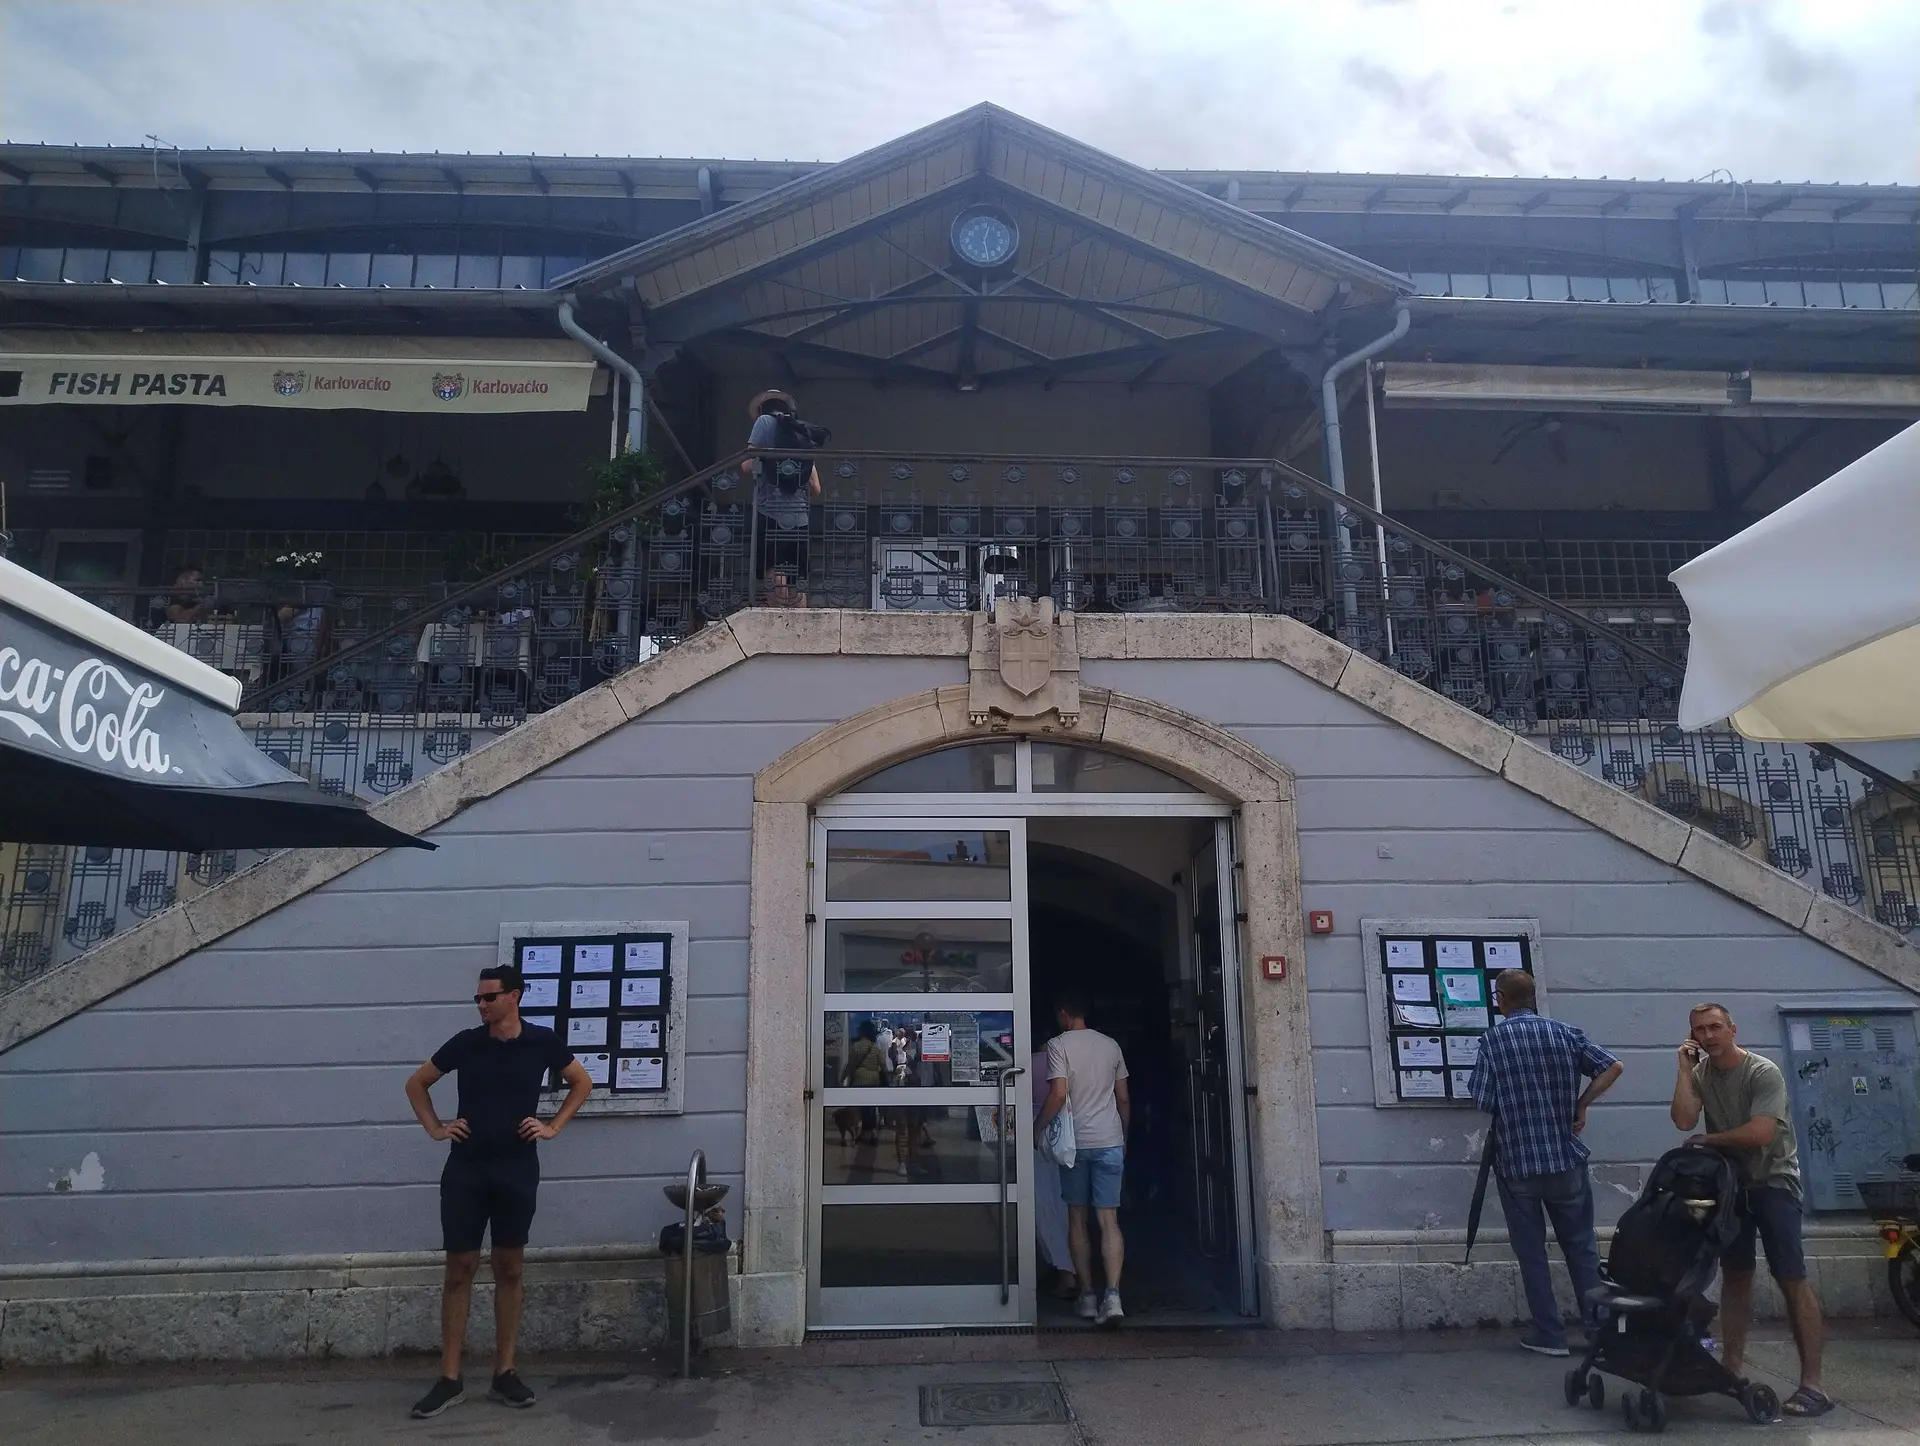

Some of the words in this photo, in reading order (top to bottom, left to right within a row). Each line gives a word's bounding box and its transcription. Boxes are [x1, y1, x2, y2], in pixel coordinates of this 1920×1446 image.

[49, 372, 121, 395] FISH
[129, 373, 227, 397] PASTA
[314, 375, 391, 391] Karlovačko
[472, 379, 549, 394] Karlovačko
